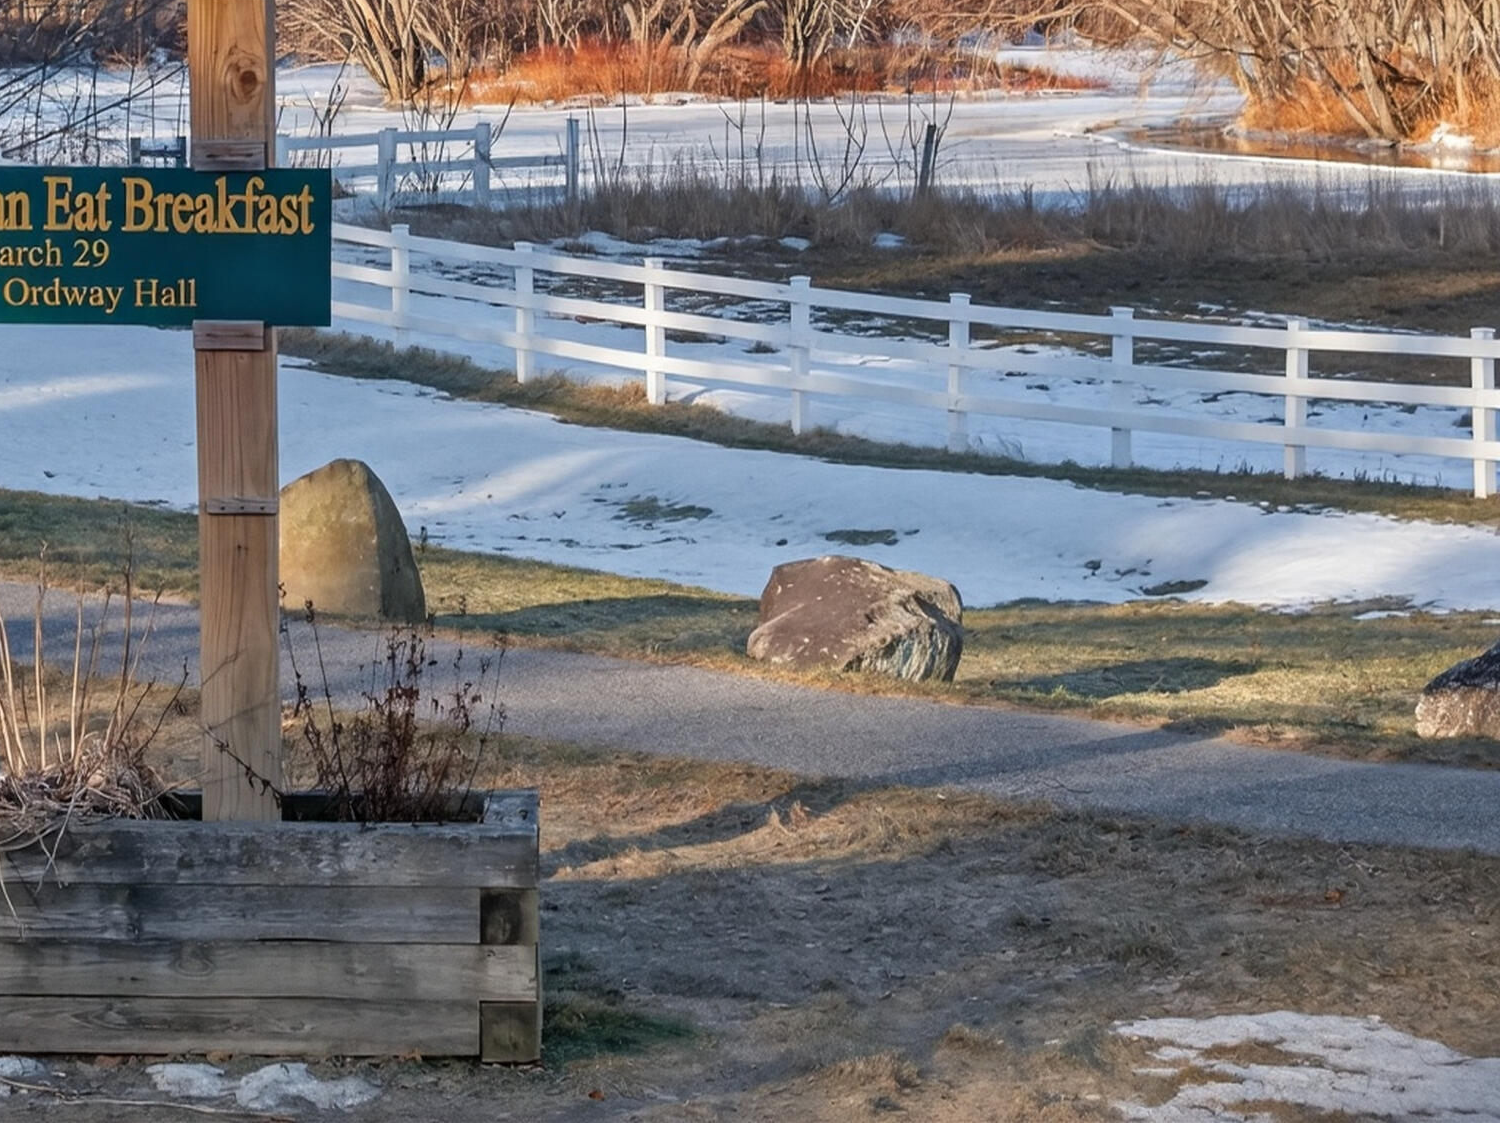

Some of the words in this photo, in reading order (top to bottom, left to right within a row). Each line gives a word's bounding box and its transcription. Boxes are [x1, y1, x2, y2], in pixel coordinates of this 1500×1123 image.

[43, 175, 112, 232] Eat
[121, 176, 316, 236] Breakfast
[72, 238, 110, 268] 29
[3, 280, 123, 316] Ordway
[134, 279, 198, 309] Hall
